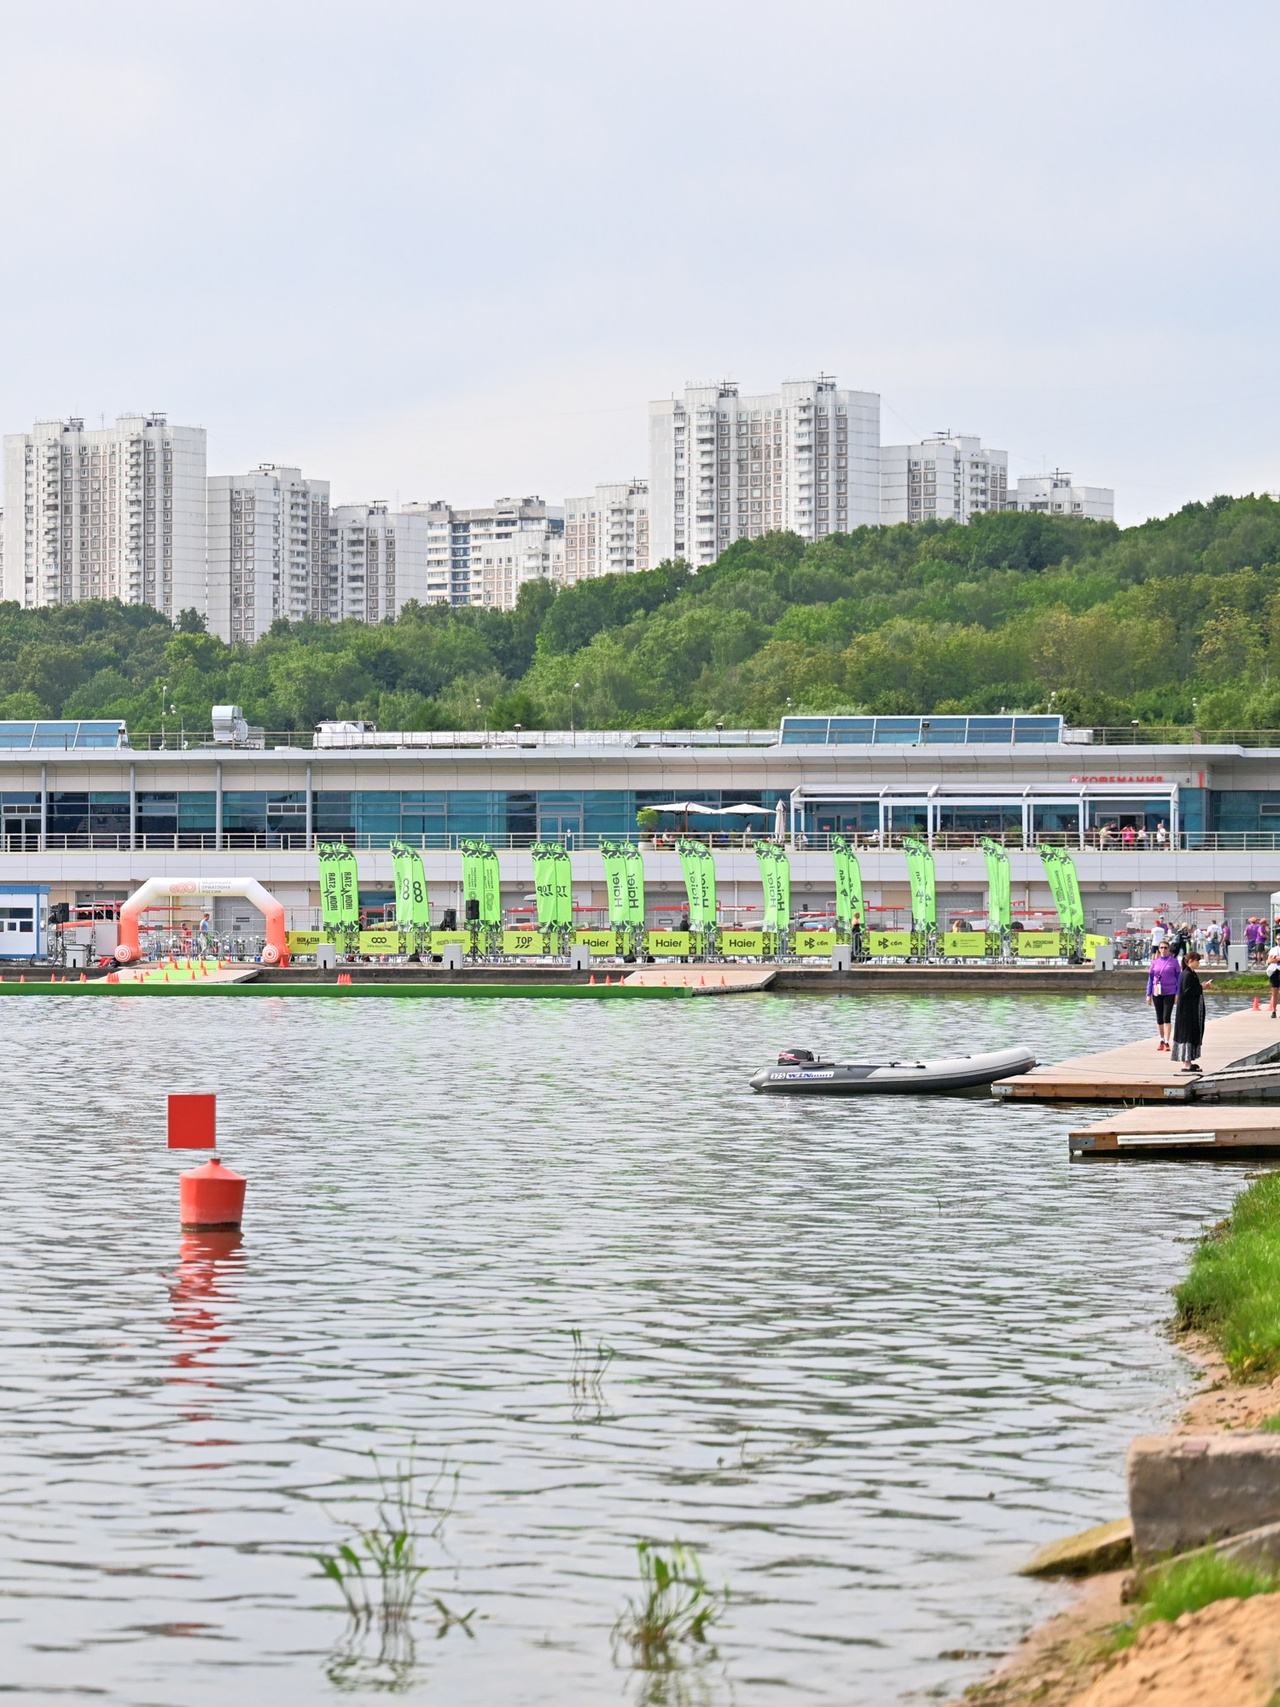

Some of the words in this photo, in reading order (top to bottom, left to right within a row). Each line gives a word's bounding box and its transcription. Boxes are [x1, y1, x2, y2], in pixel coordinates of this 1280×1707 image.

[583, 939, 609, 947] Haier
[656, 939, 682, 947] Haier
[729, 939, 756, 947] Haier
